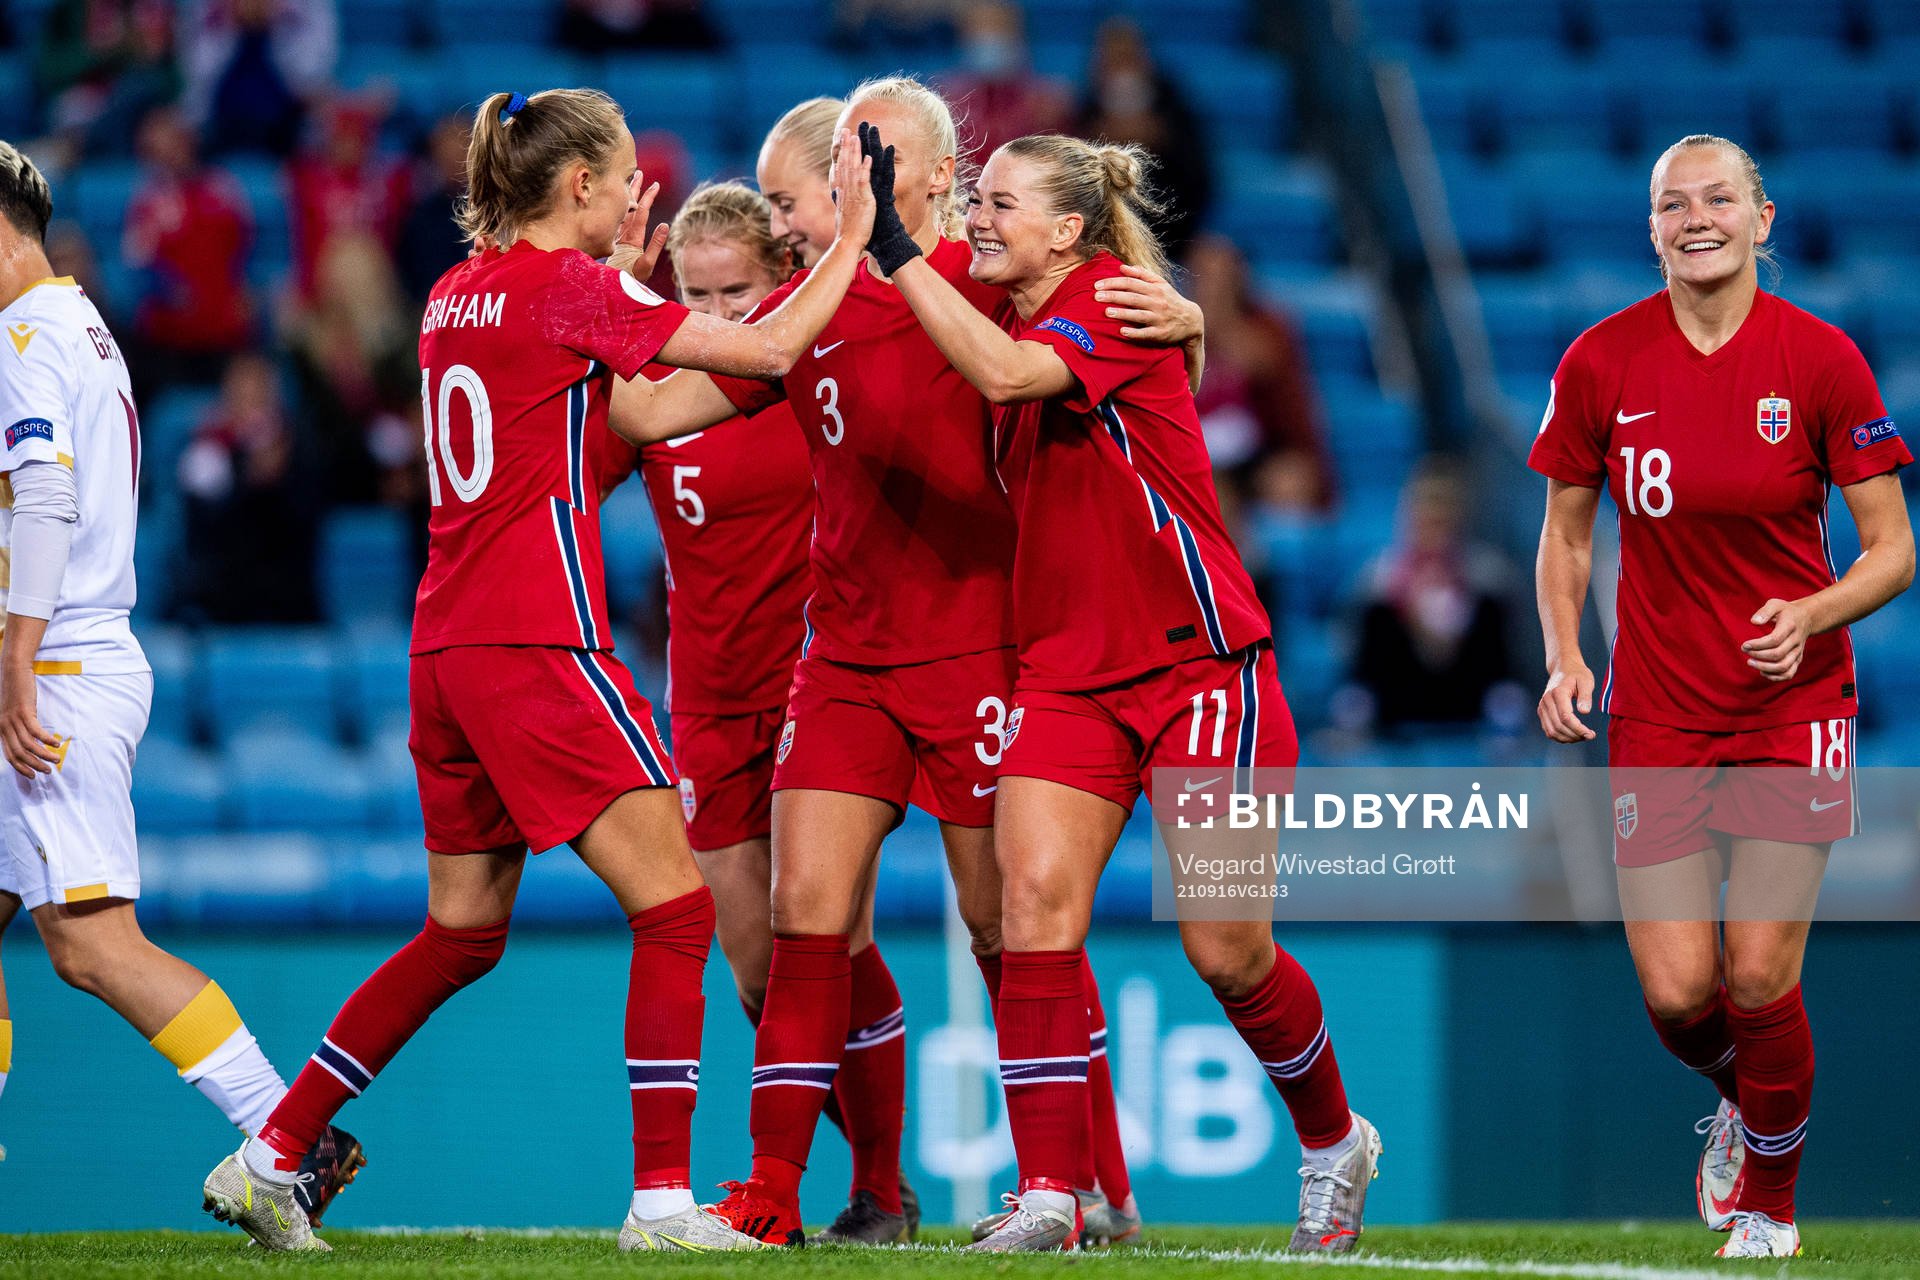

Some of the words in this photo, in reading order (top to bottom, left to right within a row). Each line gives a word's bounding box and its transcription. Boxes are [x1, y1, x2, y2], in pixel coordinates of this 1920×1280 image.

[422, 292, 507, 335] GRAHAM
[1053, 320, 1094, 352] RESPECT
[14, 422, 53, 438] RESPECT
[421, 364, 494, 507] 10
[815, 377, 845, 446] 3
[673, 464, 706, 527] 5
[1620, 447, 1674, 518] 18
[974, 695, 1007, 766] 3
[1187, 689, 1228, 758] 11
[1810, 718, 1847, 782] 18
